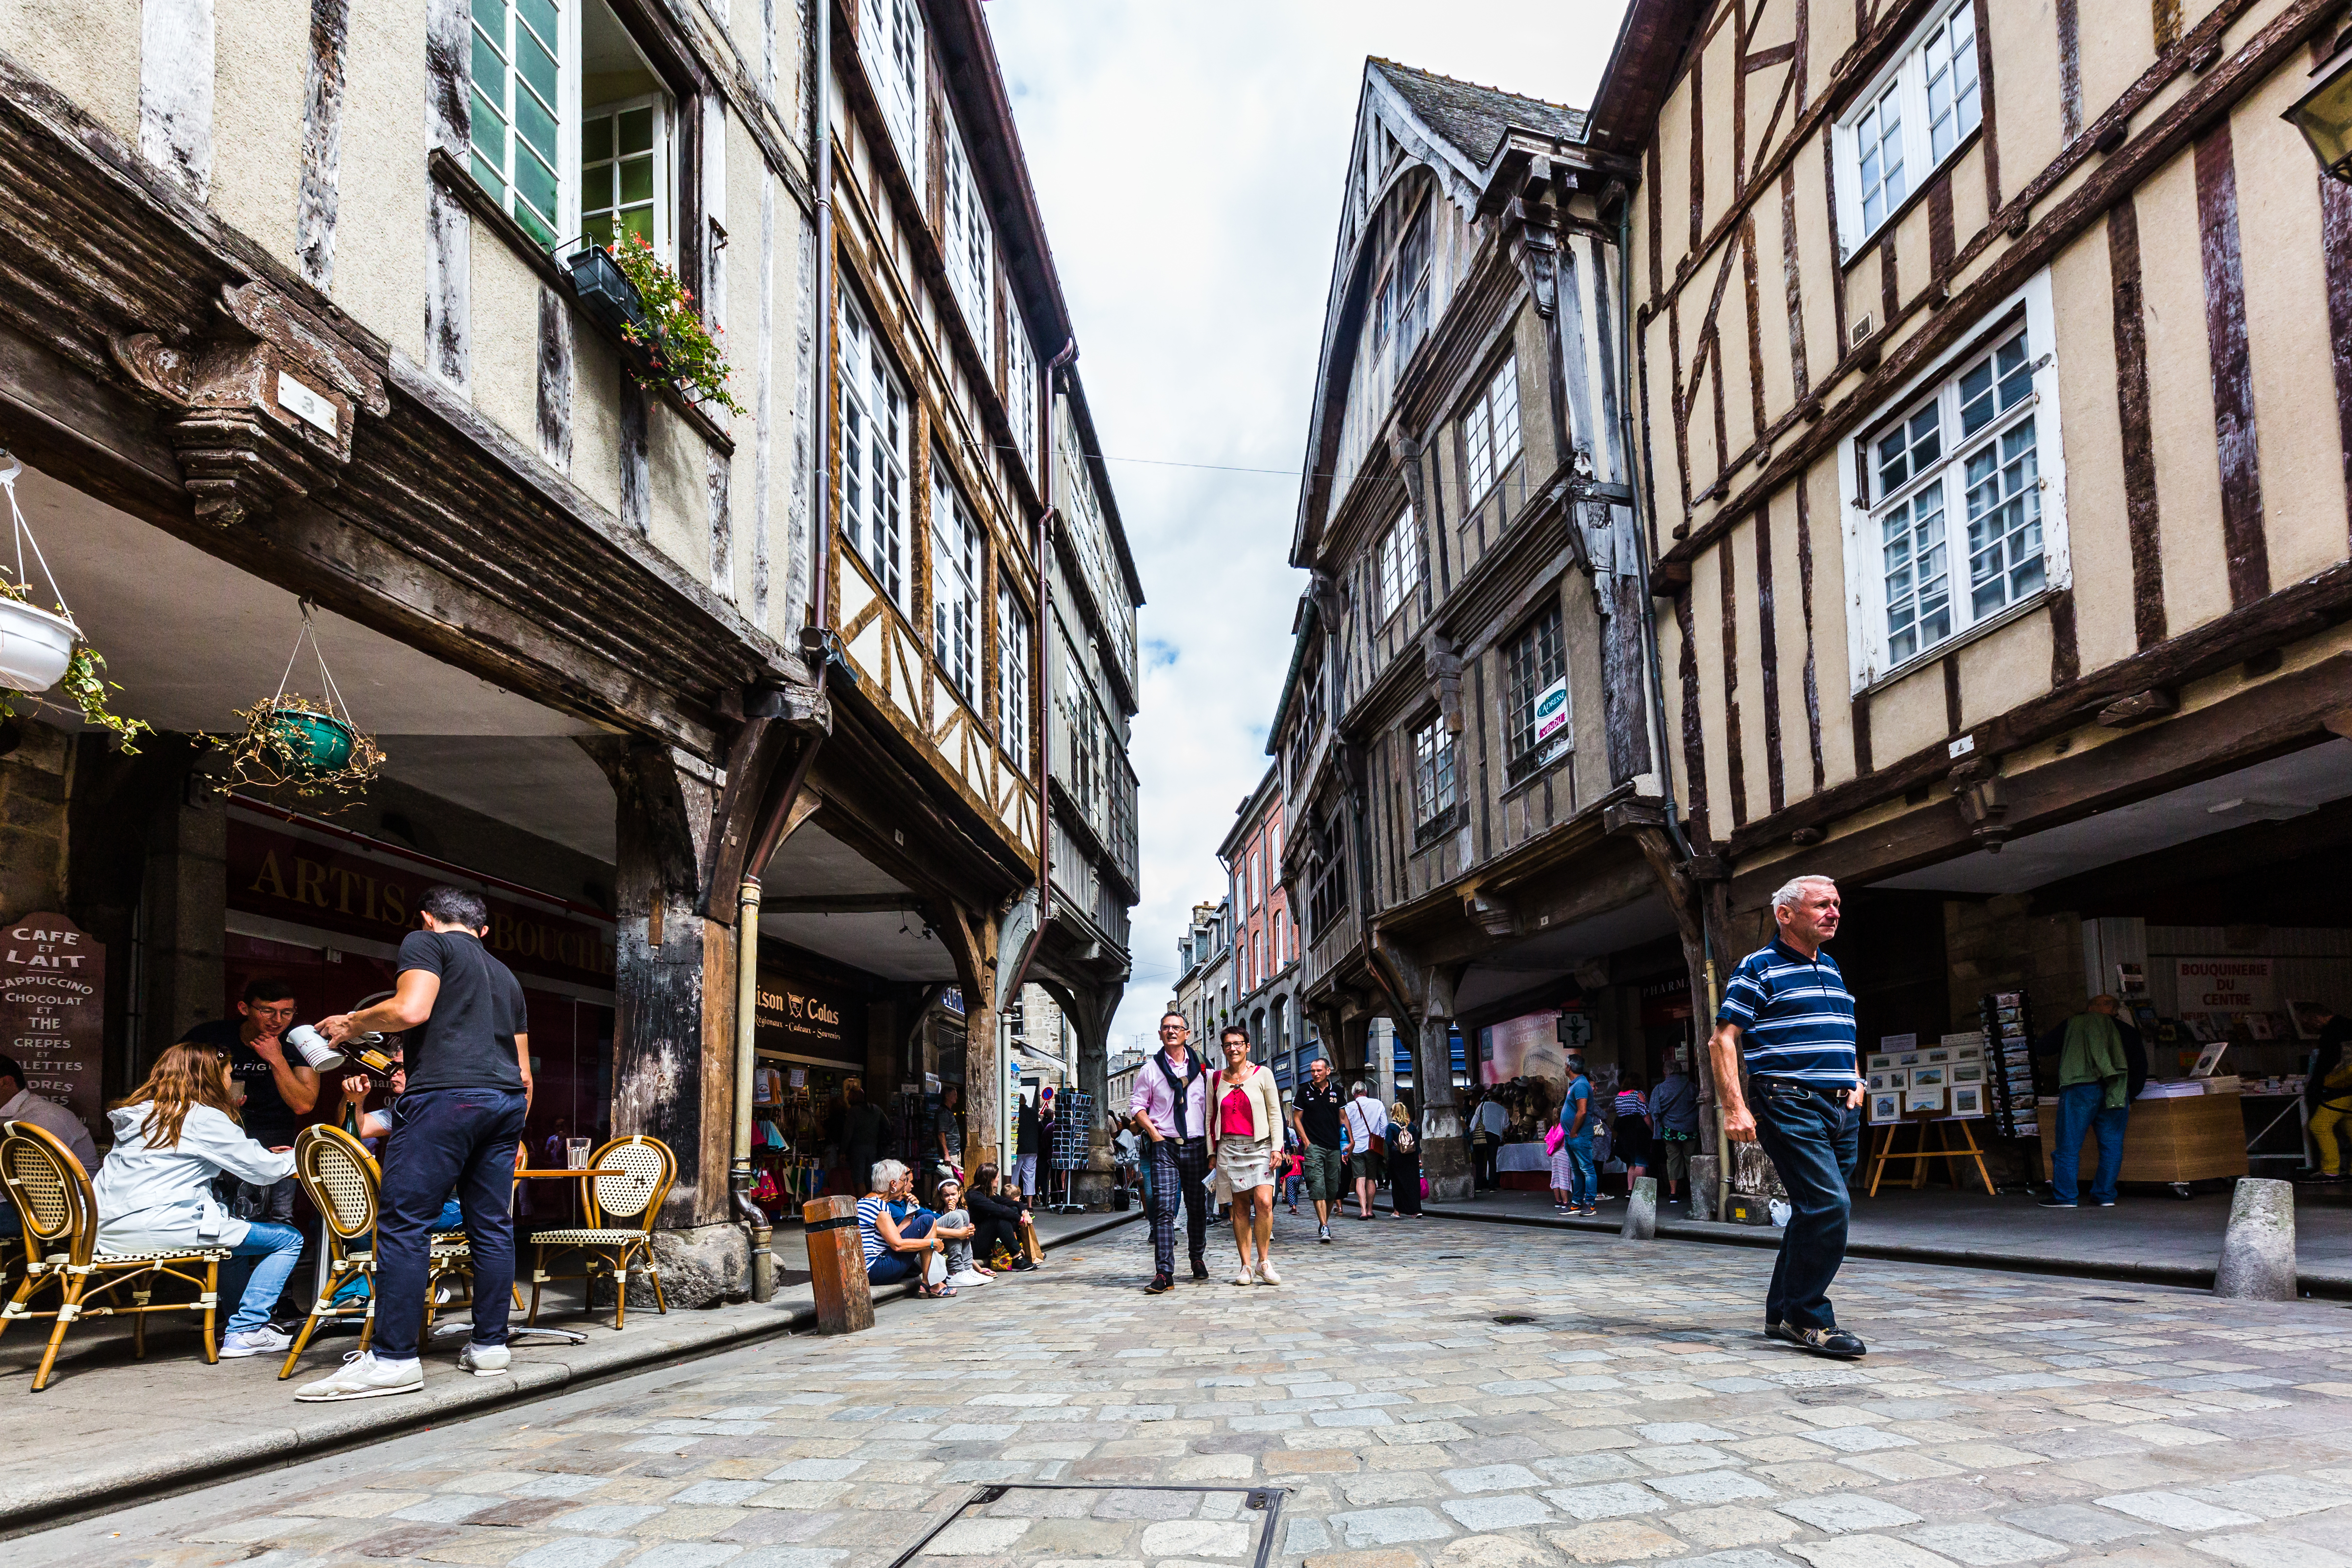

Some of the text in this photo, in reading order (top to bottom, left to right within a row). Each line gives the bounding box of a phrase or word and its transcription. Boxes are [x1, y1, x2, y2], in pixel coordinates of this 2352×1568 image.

[303, 395, 315, 414] 3
[1539, 690, 1566, 715] L'ADRESSE
[1542, 715, 1562, 735] VENDU
[12, 927, 80, 945] CAFE
[38, 944, 56, 953] ET
[6, 949, 86, 968] LAIT
[2181, 964, 2267, 977] BOUQUINERIE
[2216, 979, 2234, 990] DU
[5, 992, 84, 1006] CHOCOLAT
[755, 984, 784, 1011] ison
[807, 998, 839, 1025] Colas
[2202, 993, 2251, 1006] CENTRE
[28, 1017, 61, 1030] THE
[789, 1022, 812, 1034] Cadeaux
[817, 1028, 841, 1040] Souvenirs
[14, 1038, 71, 1049] CREPES
